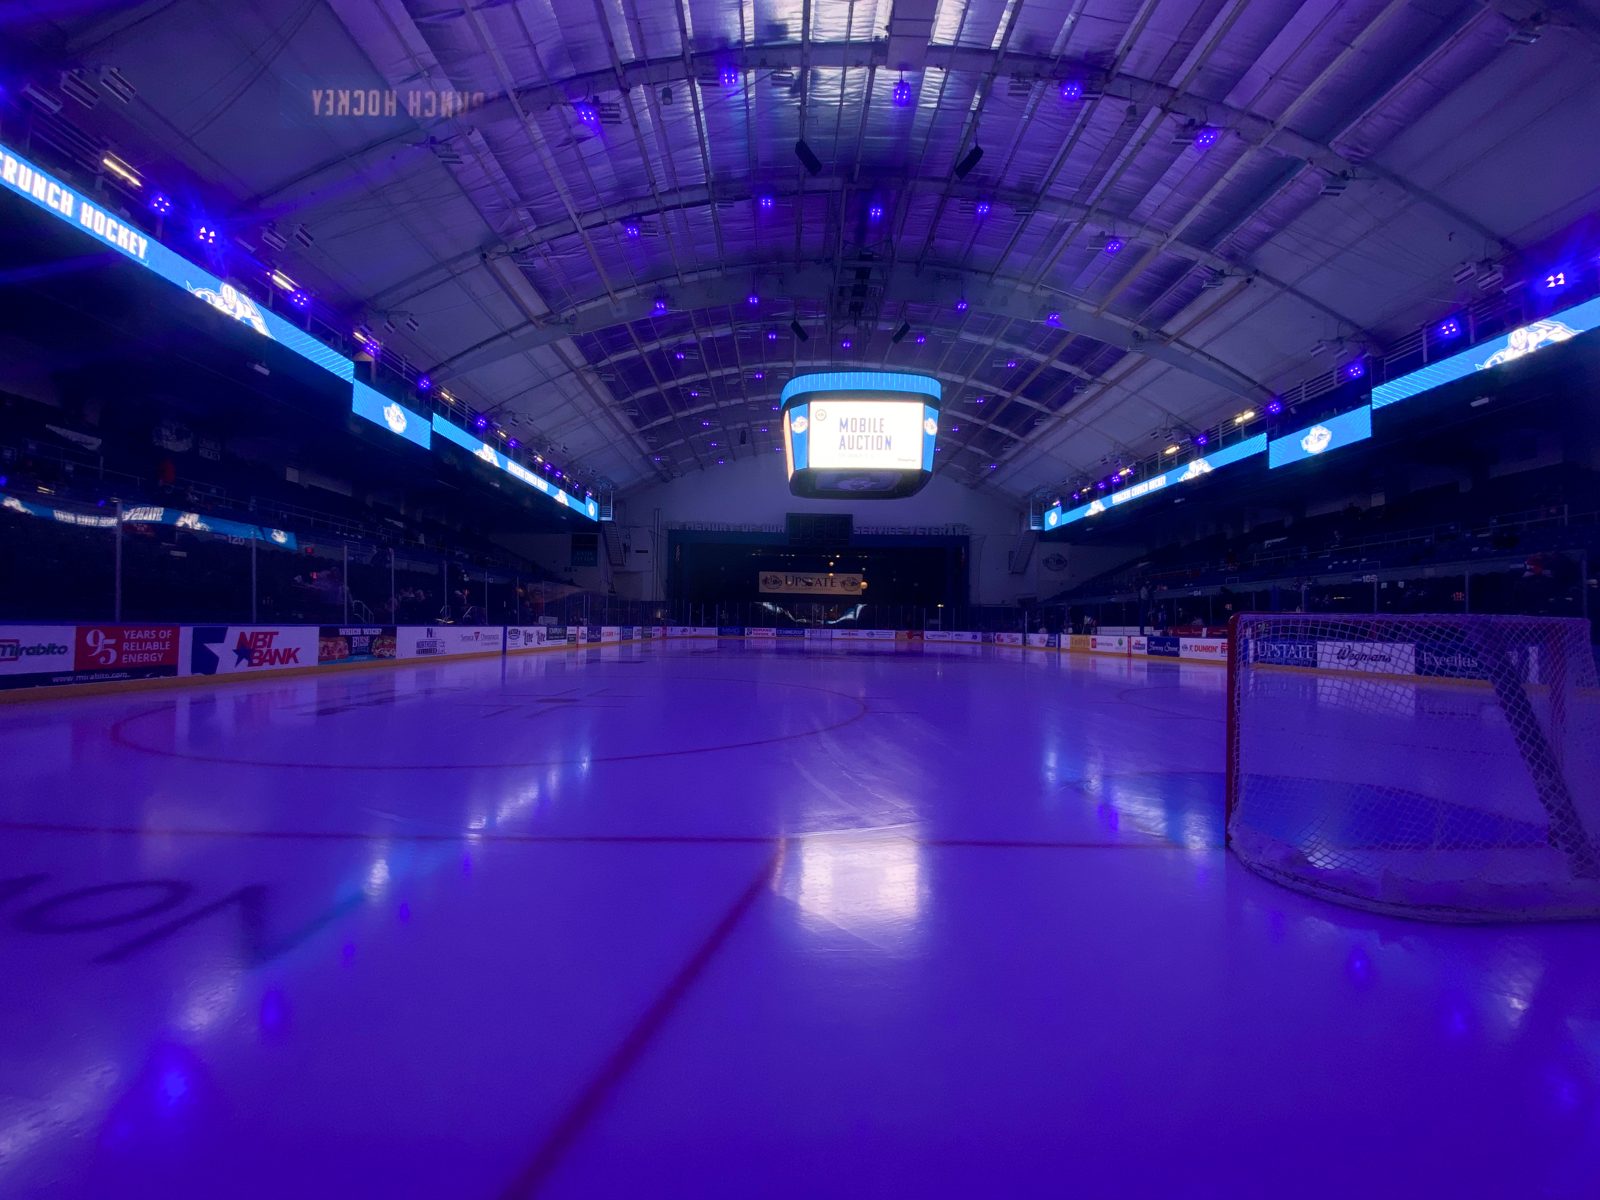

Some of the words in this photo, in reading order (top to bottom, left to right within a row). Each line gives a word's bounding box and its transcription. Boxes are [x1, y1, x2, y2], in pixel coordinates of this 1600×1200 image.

[0, 151, 74, 217] RUNCH
[80, 202, 148, 259] HOCKEY
[839, 417, 886, 433] MOBILE
[838, 434, 893, 451] AUCTION
[123, 630, 156, 640] YEARS
[159, 630, 173, 639] OF
[237, 631, 279, 650] NBT
[86, 629, 118, 665] 95
[123, 641, 171, 652] RELIABLE
[1256, 641, 1313, 659] UPSTATE
[122, 652, 164, 664] ENERGY
[247, 647, 300, 667] BANK
[1337, 645, 1393, 667] Wegmans
